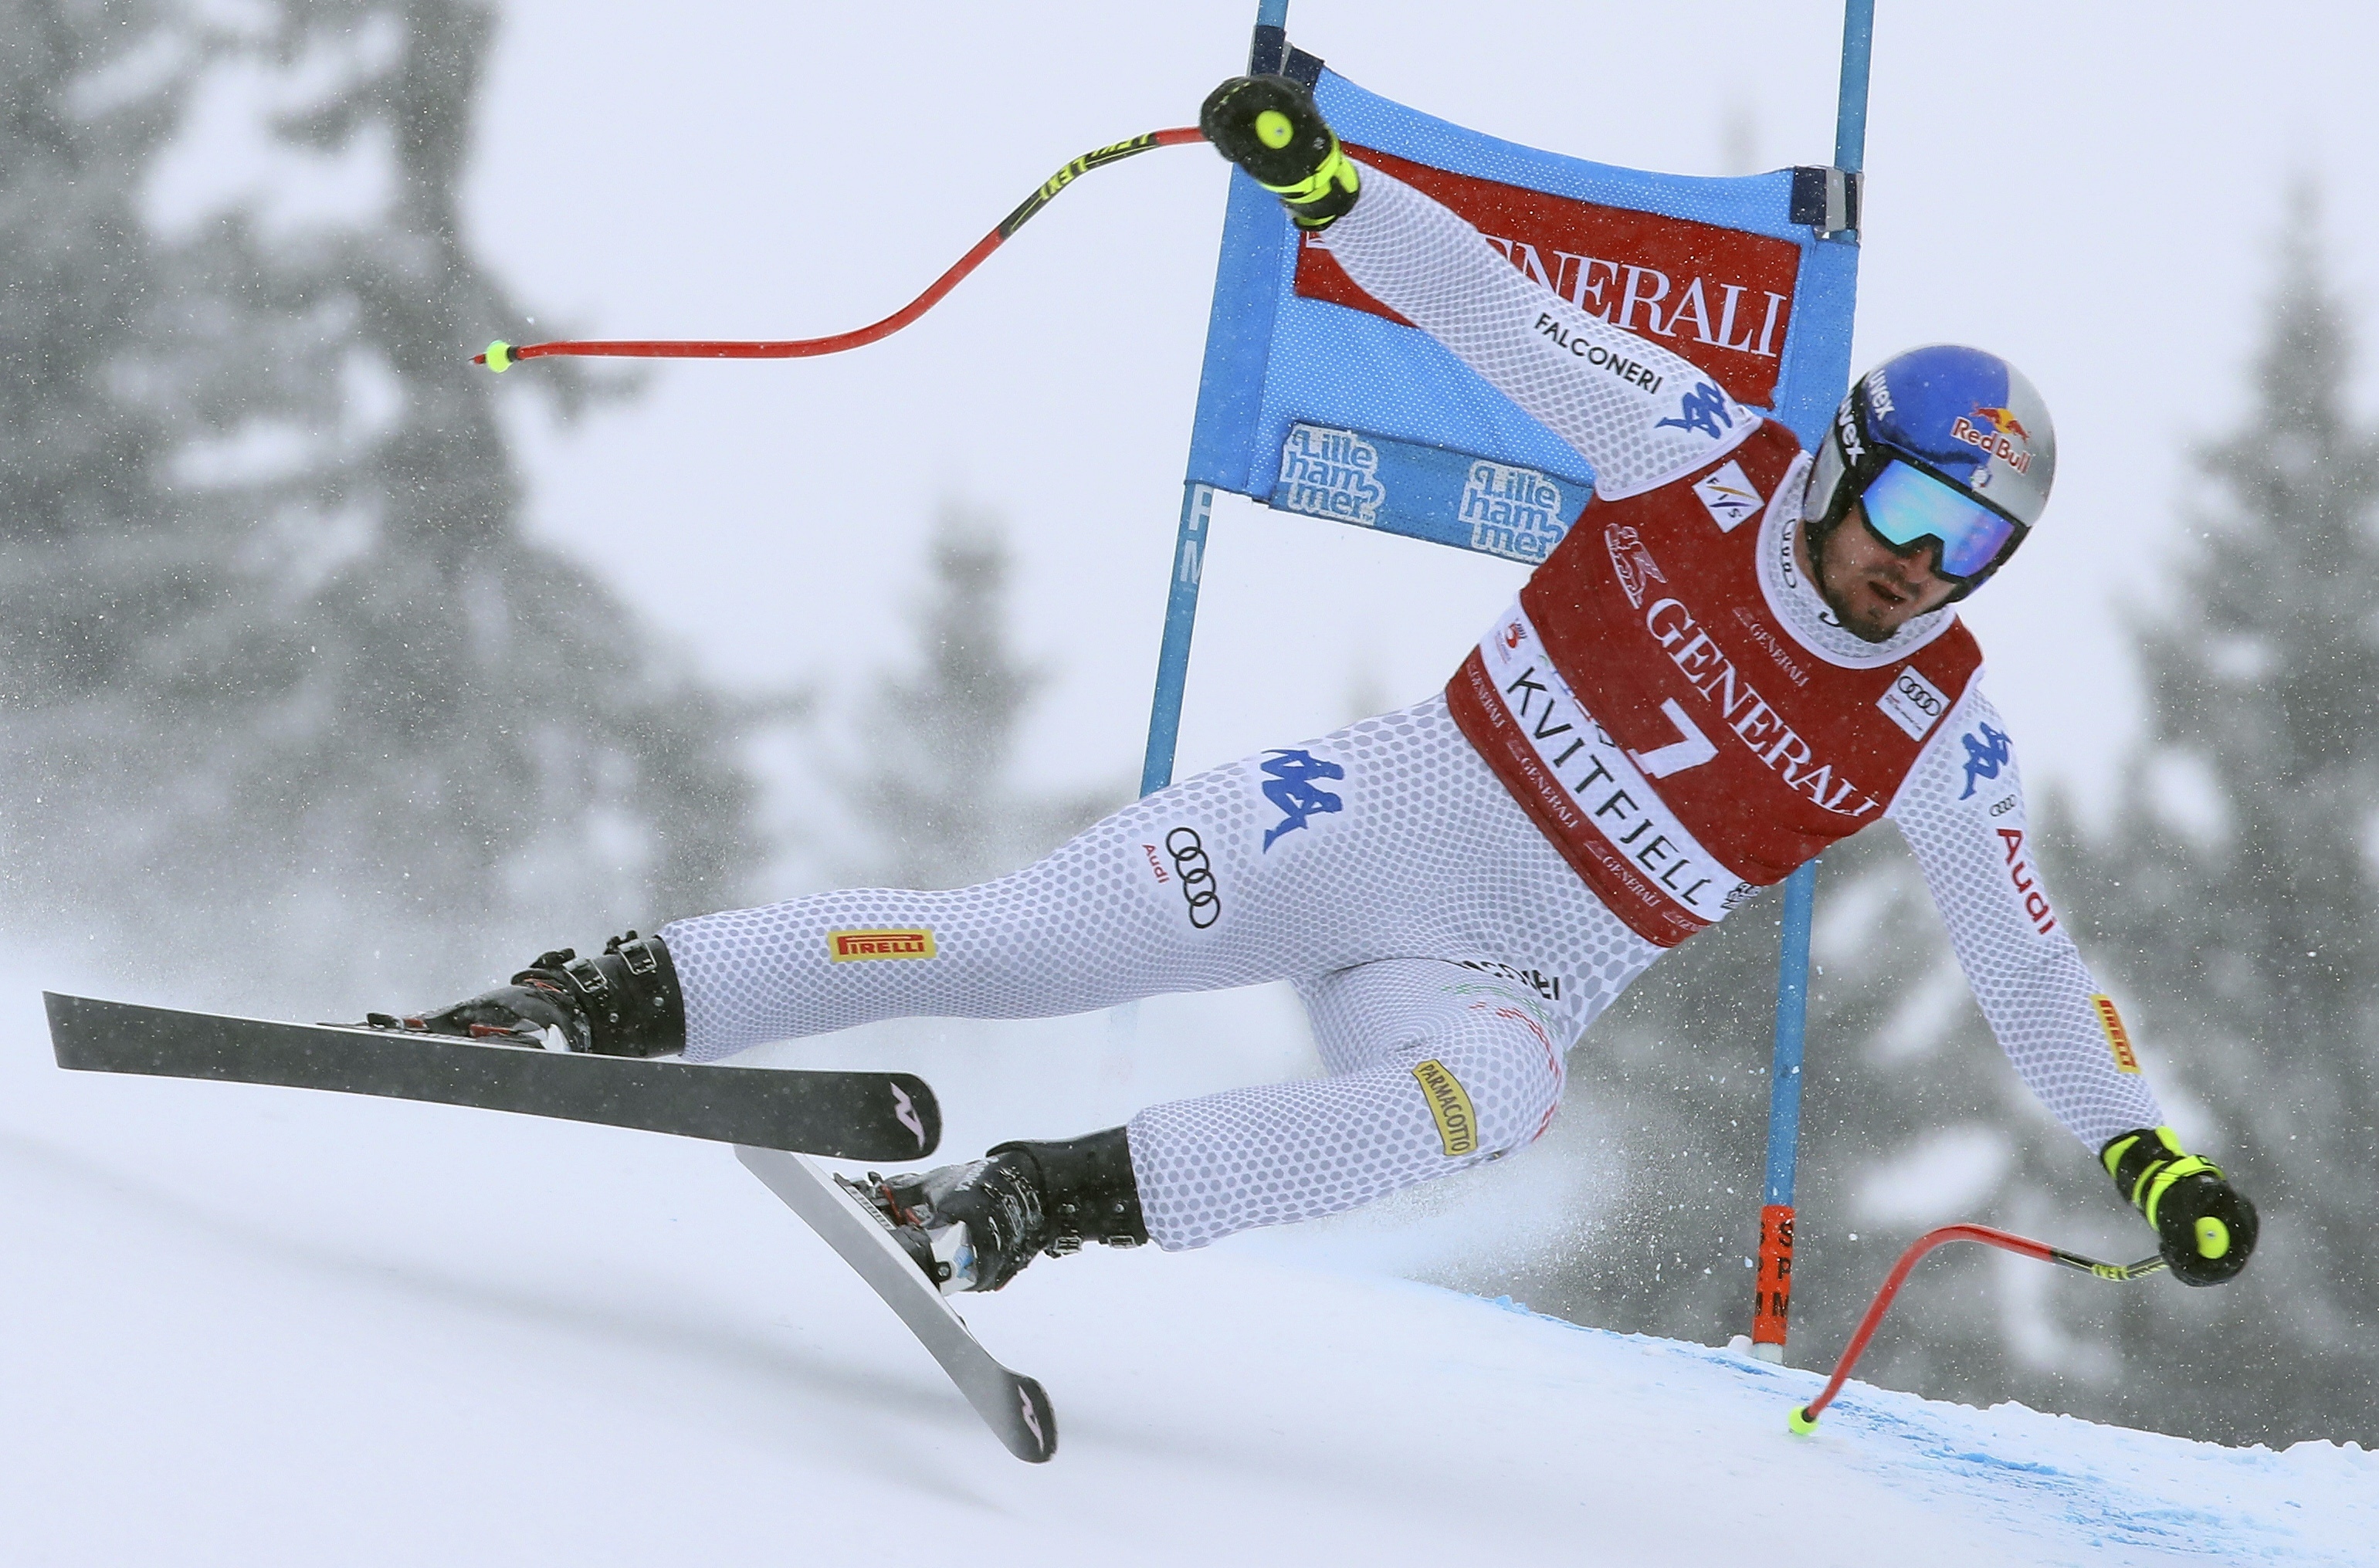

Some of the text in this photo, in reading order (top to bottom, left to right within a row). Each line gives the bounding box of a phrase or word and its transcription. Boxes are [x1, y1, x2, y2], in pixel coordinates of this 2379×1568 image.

[1479, 232, 1790, 358] NERALI
[1533, 312, 1664, 395] FALCONERI
[1868, 368, 1896, 422] uvex
[1292, 429, 1373, 469] Lille
[1950, 417, 2032, 476] Red Bull
[1288, 483, 1371, 519] mer
[1475, 466, 1557, 510] Lille
[1478, 523, 1554, 557] mer
[1750, 623, 1809, 686] GENERALI
[1646, 598, 1880, 817] GENERALI
[1629, 697, 1720, 780] 7
[1506, 666, 1712, 906] KVITFJELL
[1521, 757, 1579, 829] GENERALI
[1142, 845, 1170, 883] Audi
[1602, 855, 1662, 909] GENERALI
[1996, 828, 2057, 935] Audi
[838, 934, 924, 955] PIRELLI
[1418, 1064, 1470, 1151] PARMACOTTO
